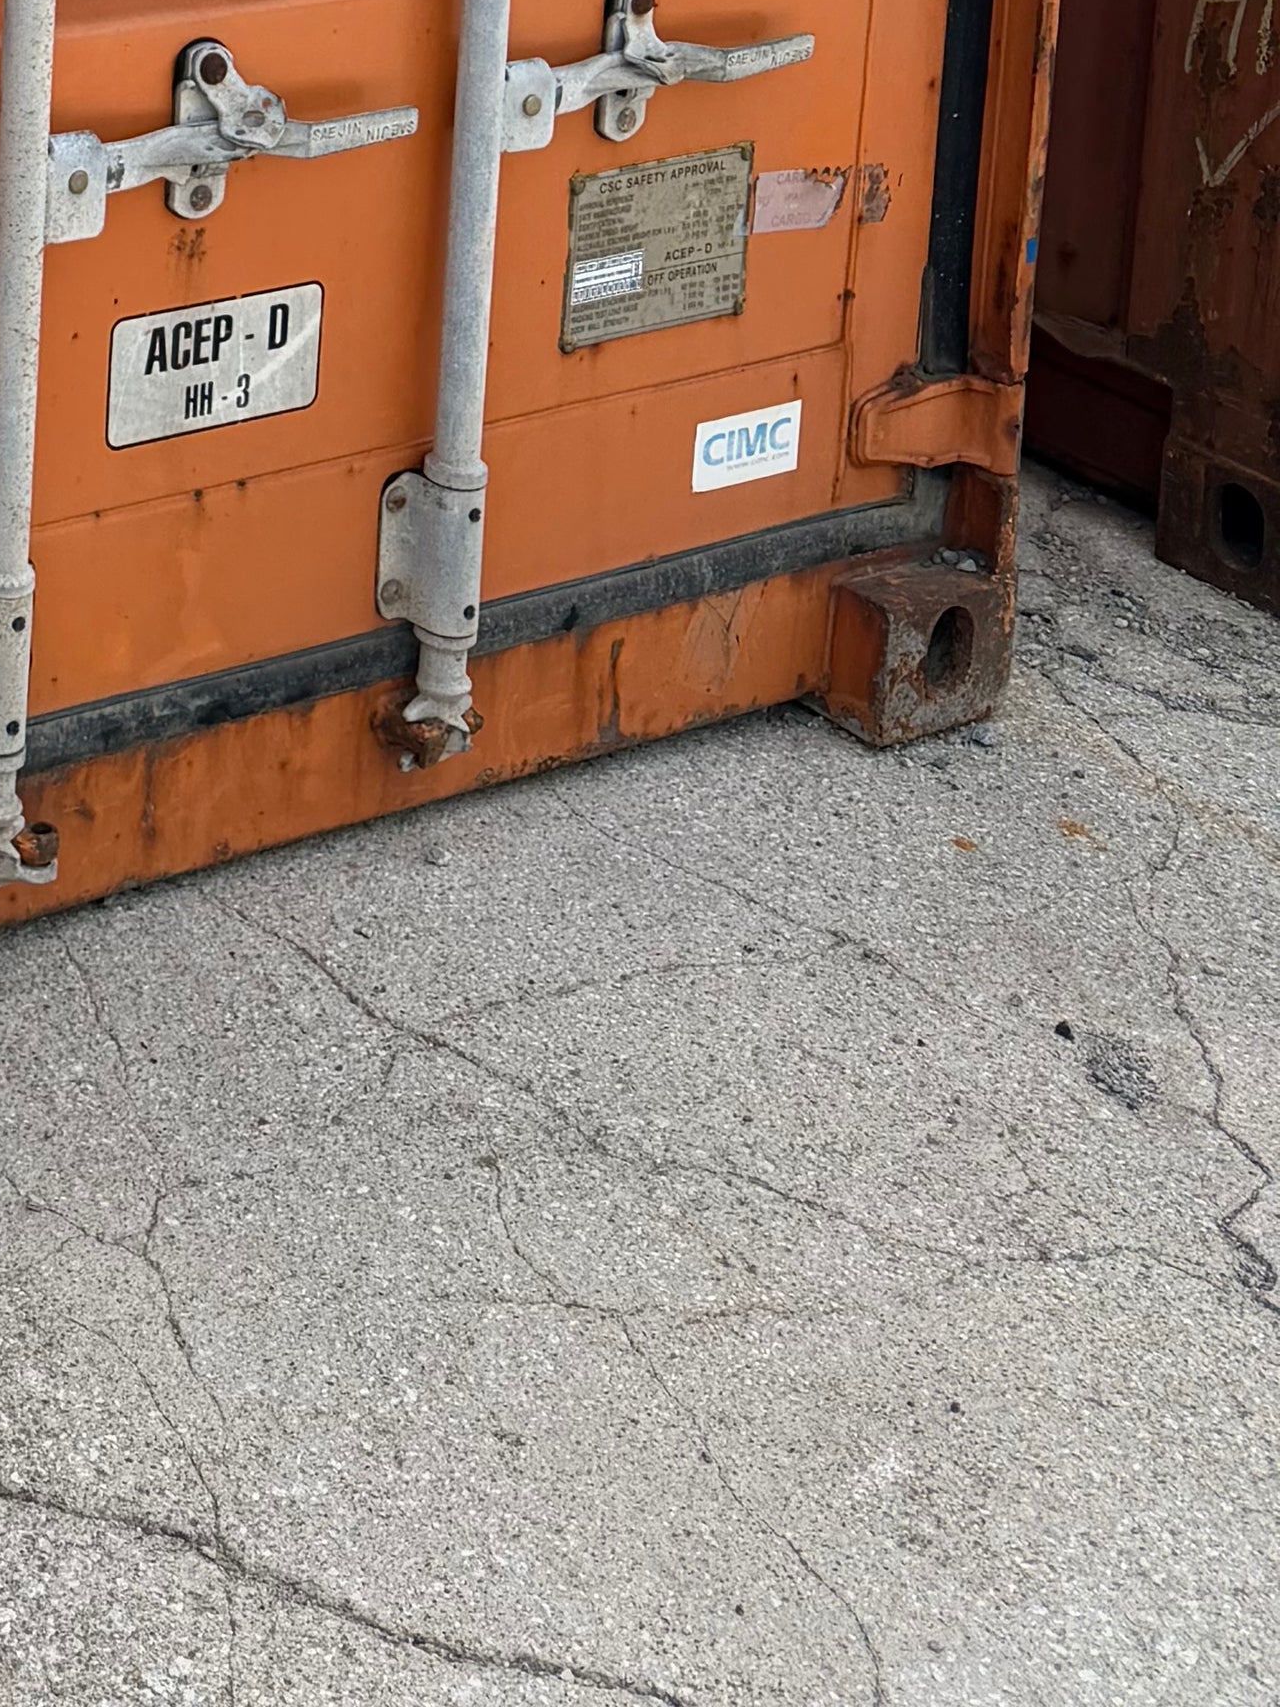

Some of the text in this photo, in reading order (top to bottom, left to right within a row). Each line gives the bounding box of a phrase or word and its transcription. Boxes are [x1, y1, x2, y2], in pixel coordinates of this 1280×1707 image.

[599, 179, 623, 195] CSC
[626, 171, 667, 189] SAFETY
[670, 160, 727, 180] APPROVAL
[647, 271, 665, 287] OFF
[668, 261, 718, 282] OPERATION
[144, 313, 234, 376] ACEP
[702, 416, 792, 466] CIMC
